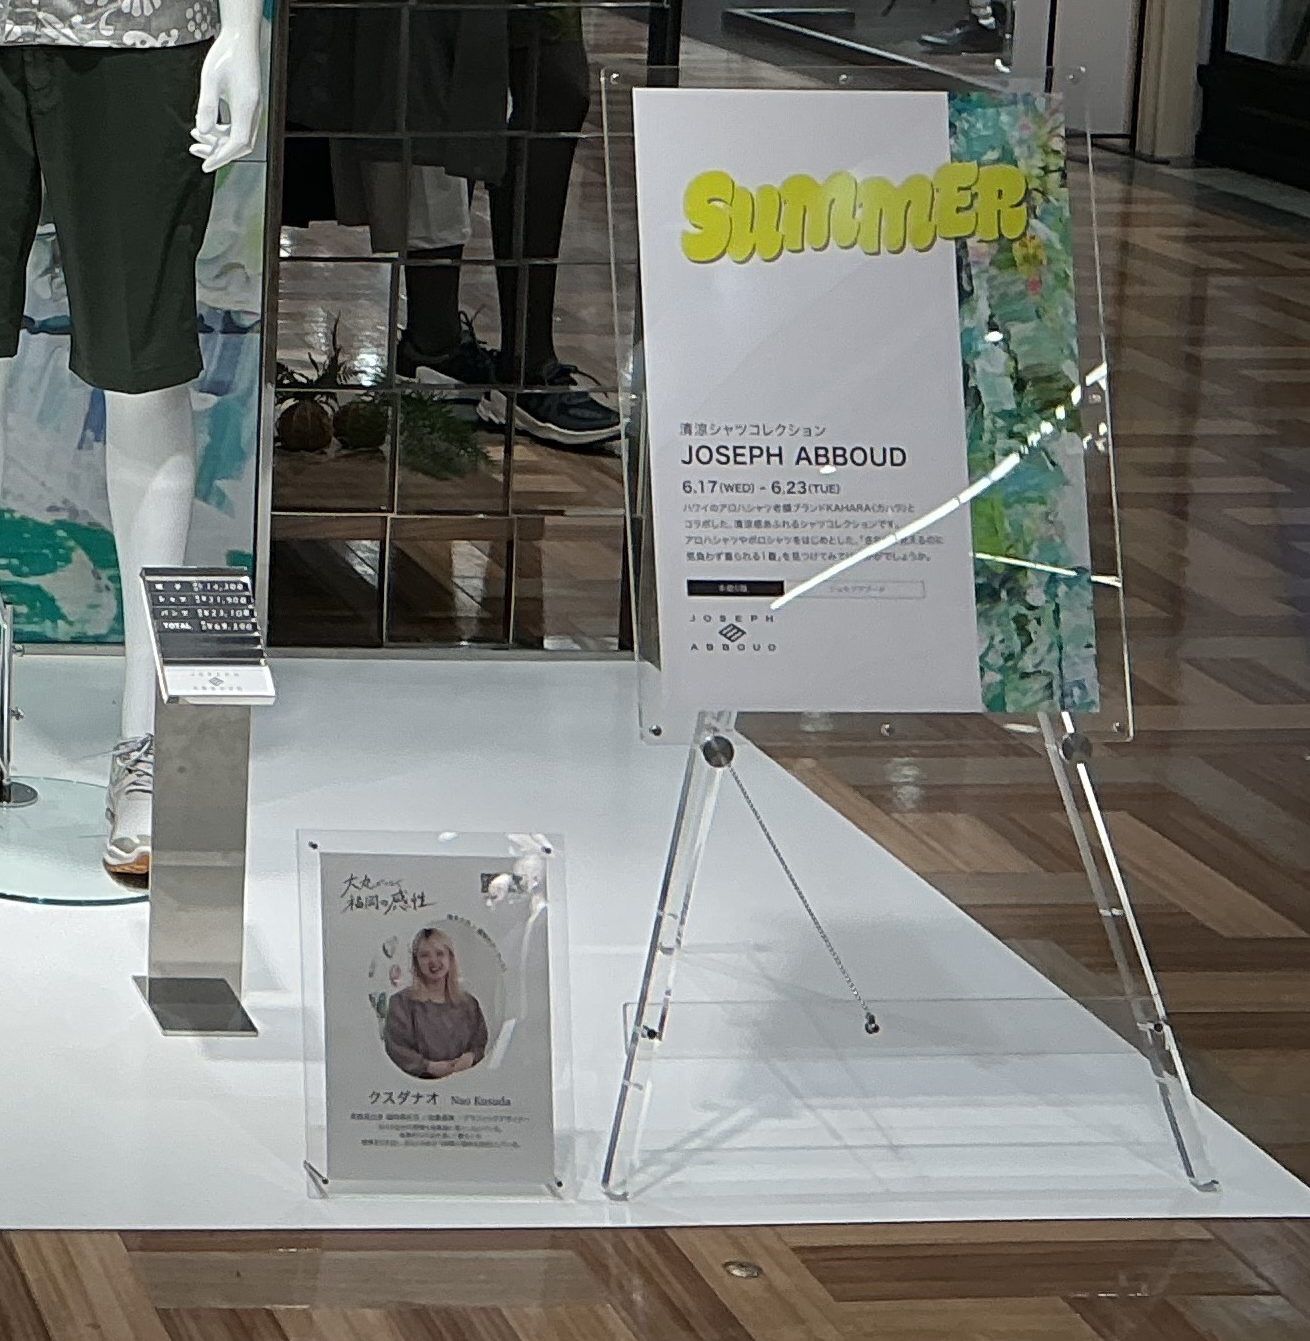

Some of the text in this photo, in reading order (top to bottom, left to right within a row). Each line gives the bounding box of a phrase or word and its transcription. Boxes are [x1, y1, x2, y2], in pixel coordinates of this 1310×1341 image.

[680, 444, 907, 467] JOSEPH ABBOUD
[689, 614, 774, 623] JOSEPH
[368, 1090, 439, 1106] クスダナオ
